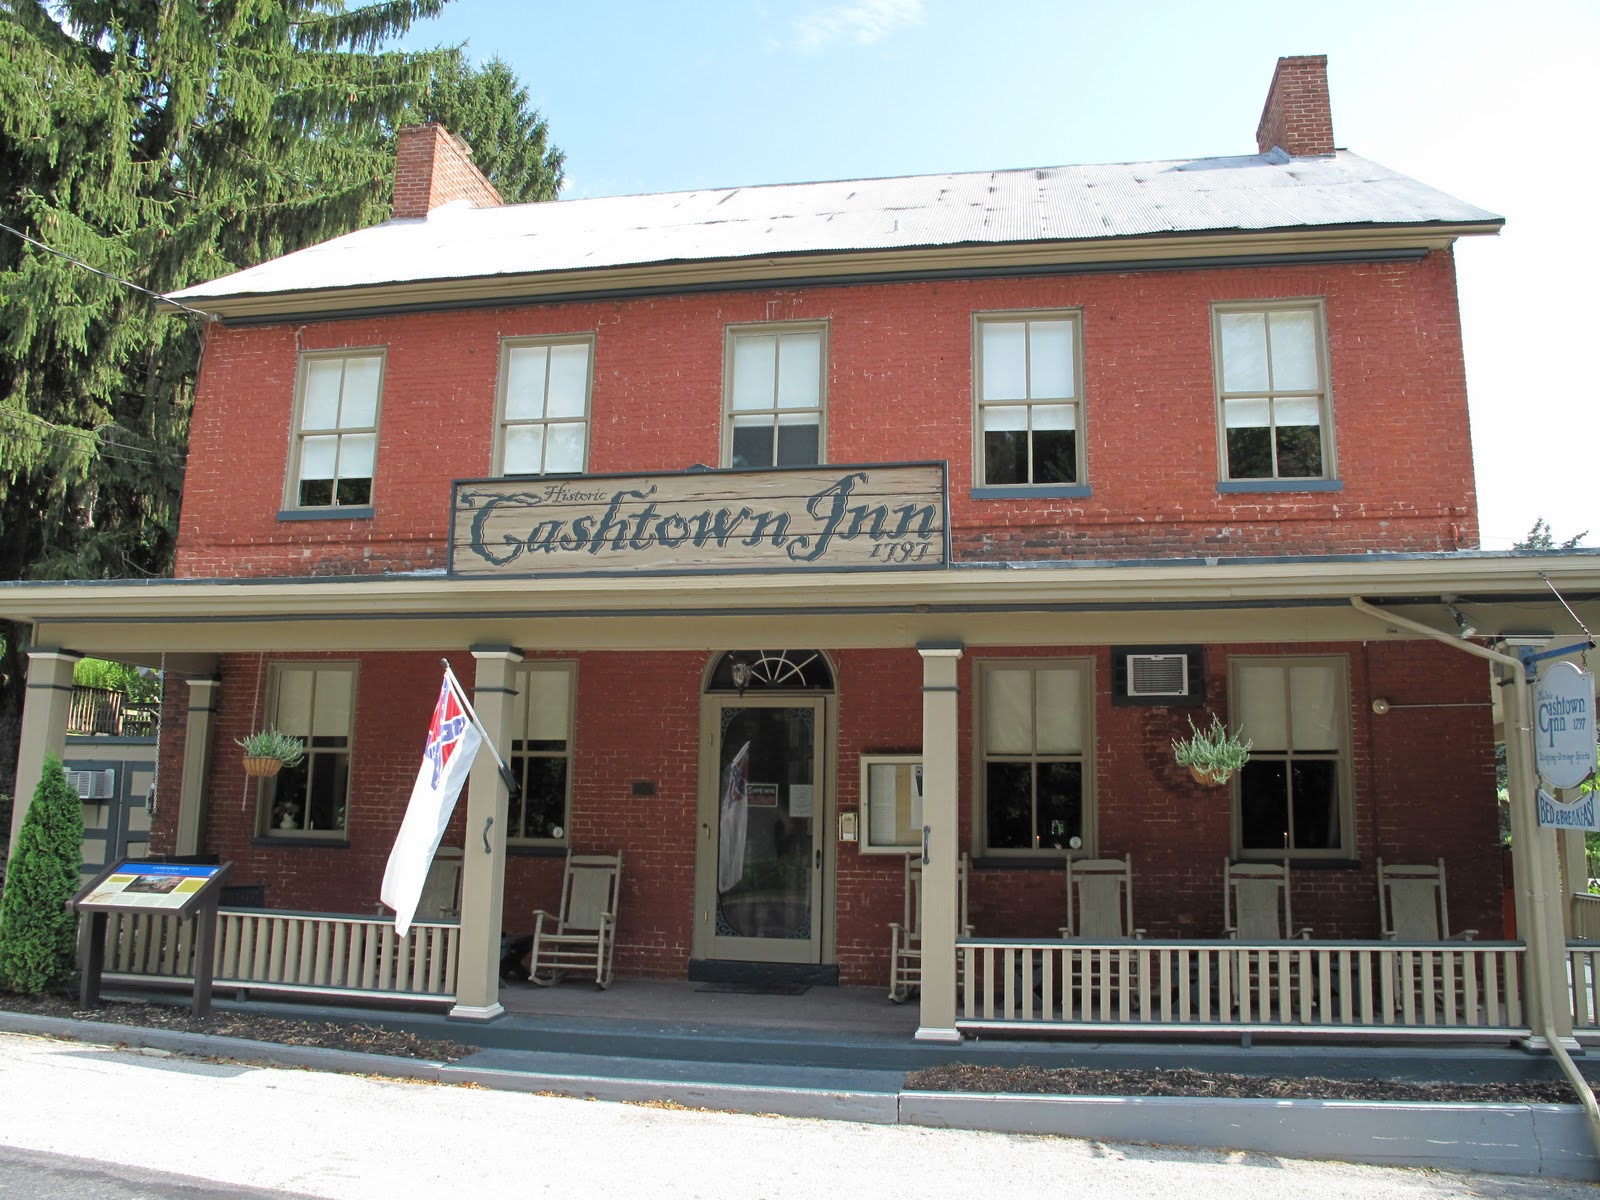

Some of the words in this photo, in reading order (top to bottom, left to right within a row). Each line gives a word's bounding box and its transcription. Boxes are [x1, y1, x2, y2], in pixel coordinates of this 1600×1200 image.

[544, 482, 608, 503] Historic
[461, 484, 791, 567] Cashtown
[786, 472, 936, 562] Inn
[868, 541, 933, 563] 1797
[1539, 695, 1585, 733] Cashtown
[1549, 716, 1566, 748] Inn
[1573, 717, 1586, 730] 1797
[1540, 796, 1555, 824] BED
[1560, 798, 1595, 827] BREAKFAST
